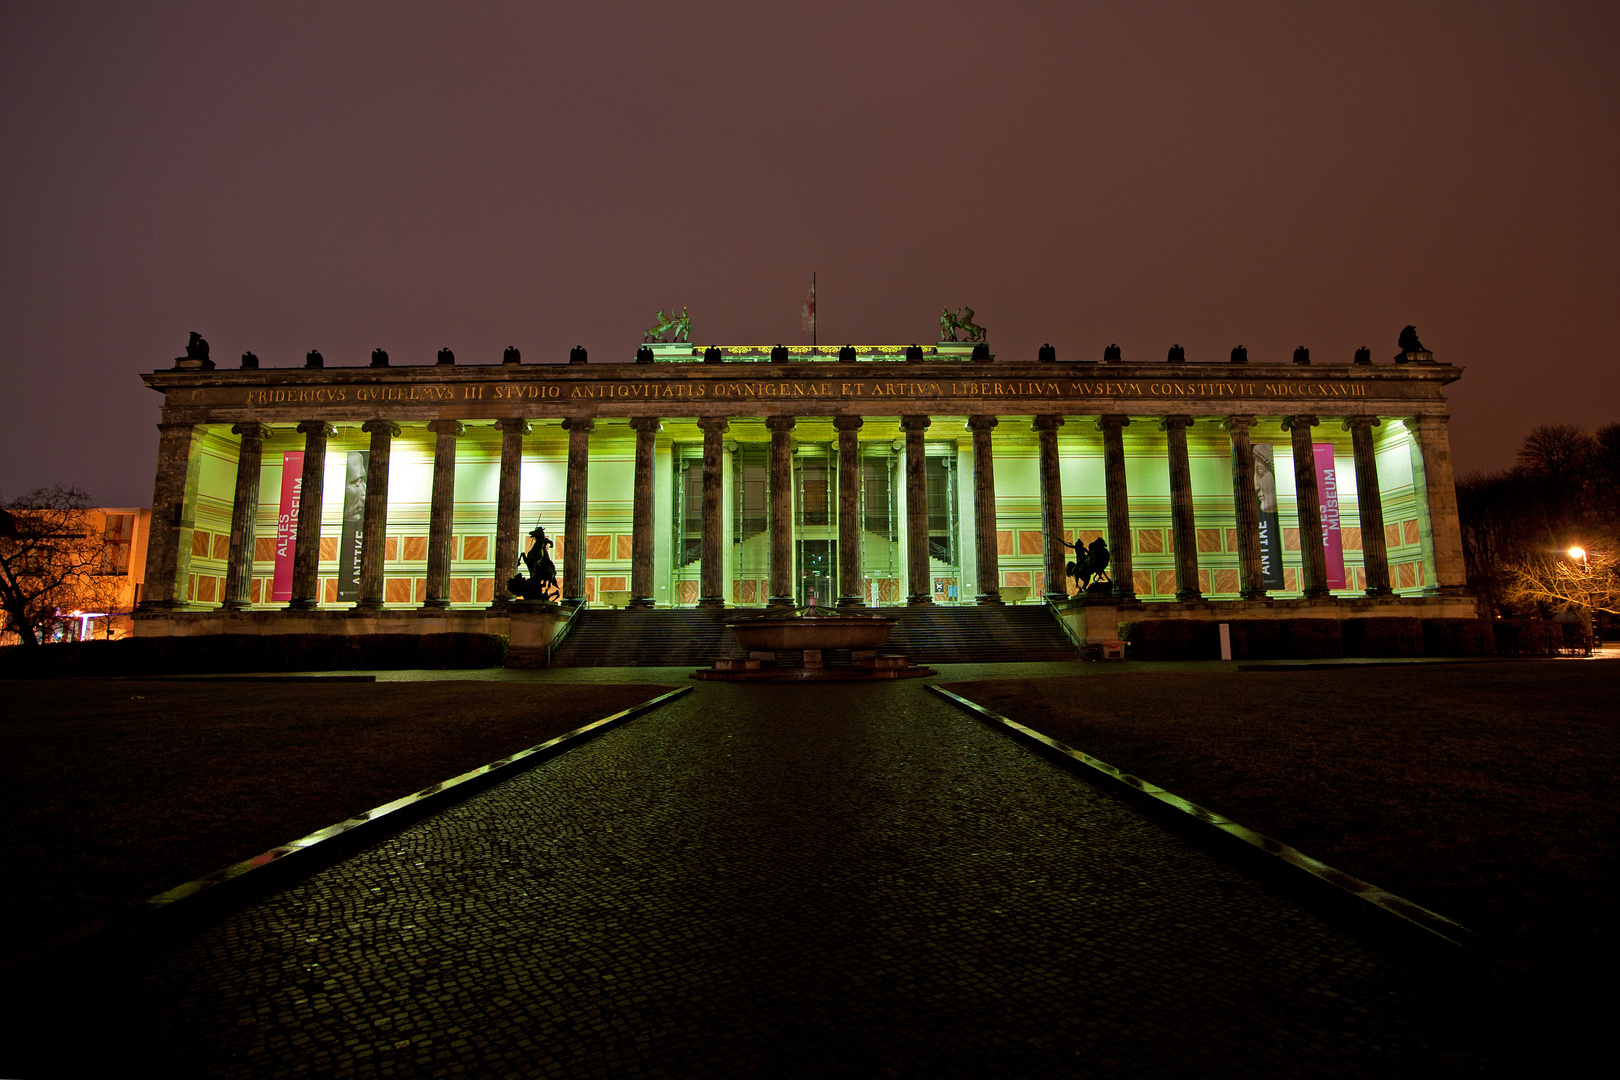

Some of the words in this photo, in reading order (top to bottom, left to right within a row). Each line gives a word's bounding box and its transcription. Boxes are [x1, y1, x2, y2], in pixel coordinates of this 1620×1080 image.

[248, 389, 346, 402] FRIDERICVS
[357, 387, 454, 401] GVILELMVS
[464, 386, 483, 399] III
[494, 385, 560, 398] STVDIO
[571, 384, 705, 397] ANTIQVITATIS
[715, 383, 832, 396] OMNIGENAE
[842, 383, 864, 395] ET
[872, 383, 943, 395] ARTIVM
[952, 383, 1061, 395] LIBERALIVM
[1070, 383, 1142, 395] MVSEVM
[1150, 383, 1255, 395] CONSTITVIT
[1264, 384, 1365, 396] MDCCCXXVIII
[1323, 469, 1340, 530] MUSEUM
[277, 514, 290, 557] ALTES
